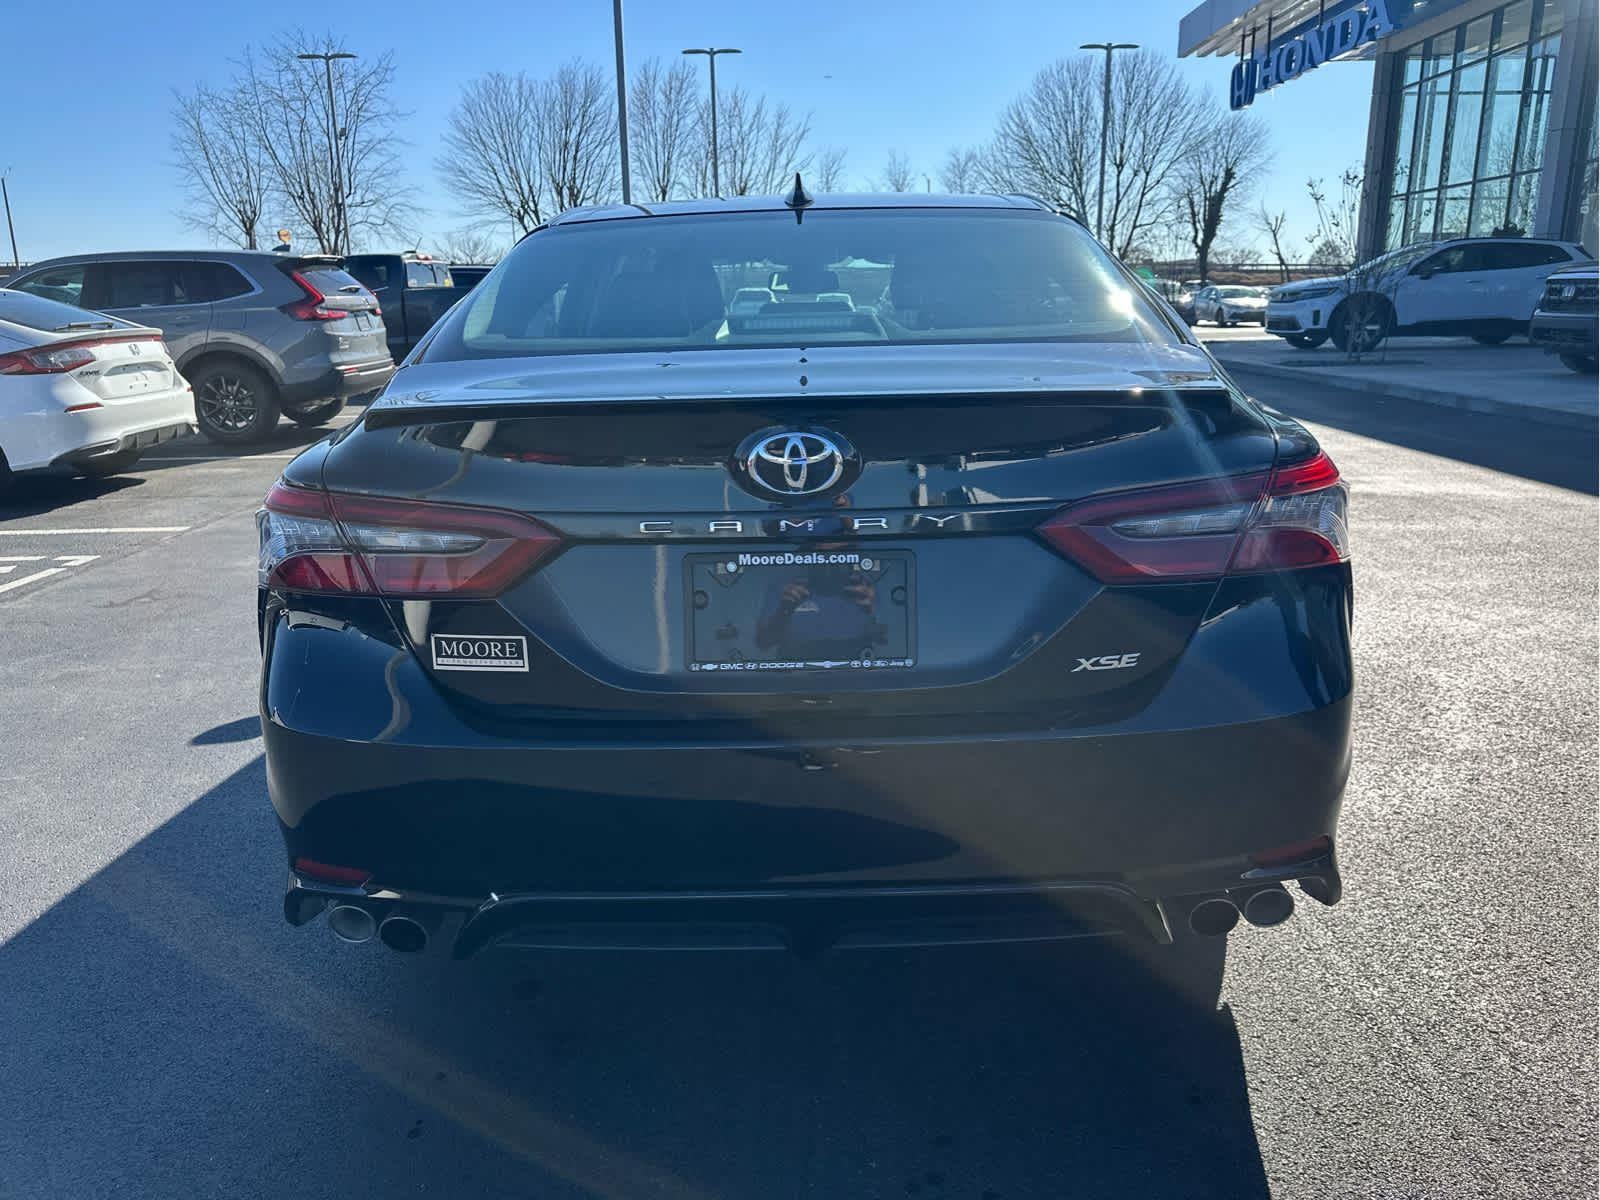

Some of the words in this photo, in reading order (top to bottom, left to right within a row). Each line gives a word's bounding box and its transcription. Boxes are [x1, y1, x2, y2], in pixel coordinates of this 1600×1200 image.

[1256, 0, 1393, 93] HONDA
[639, 513, 962, 533] CAMRY
[738, 553, 860, 566] MooreDeals.com
[440, 640, 518, 658] MOORE
[1070, 653, 1141, 673] XSE
